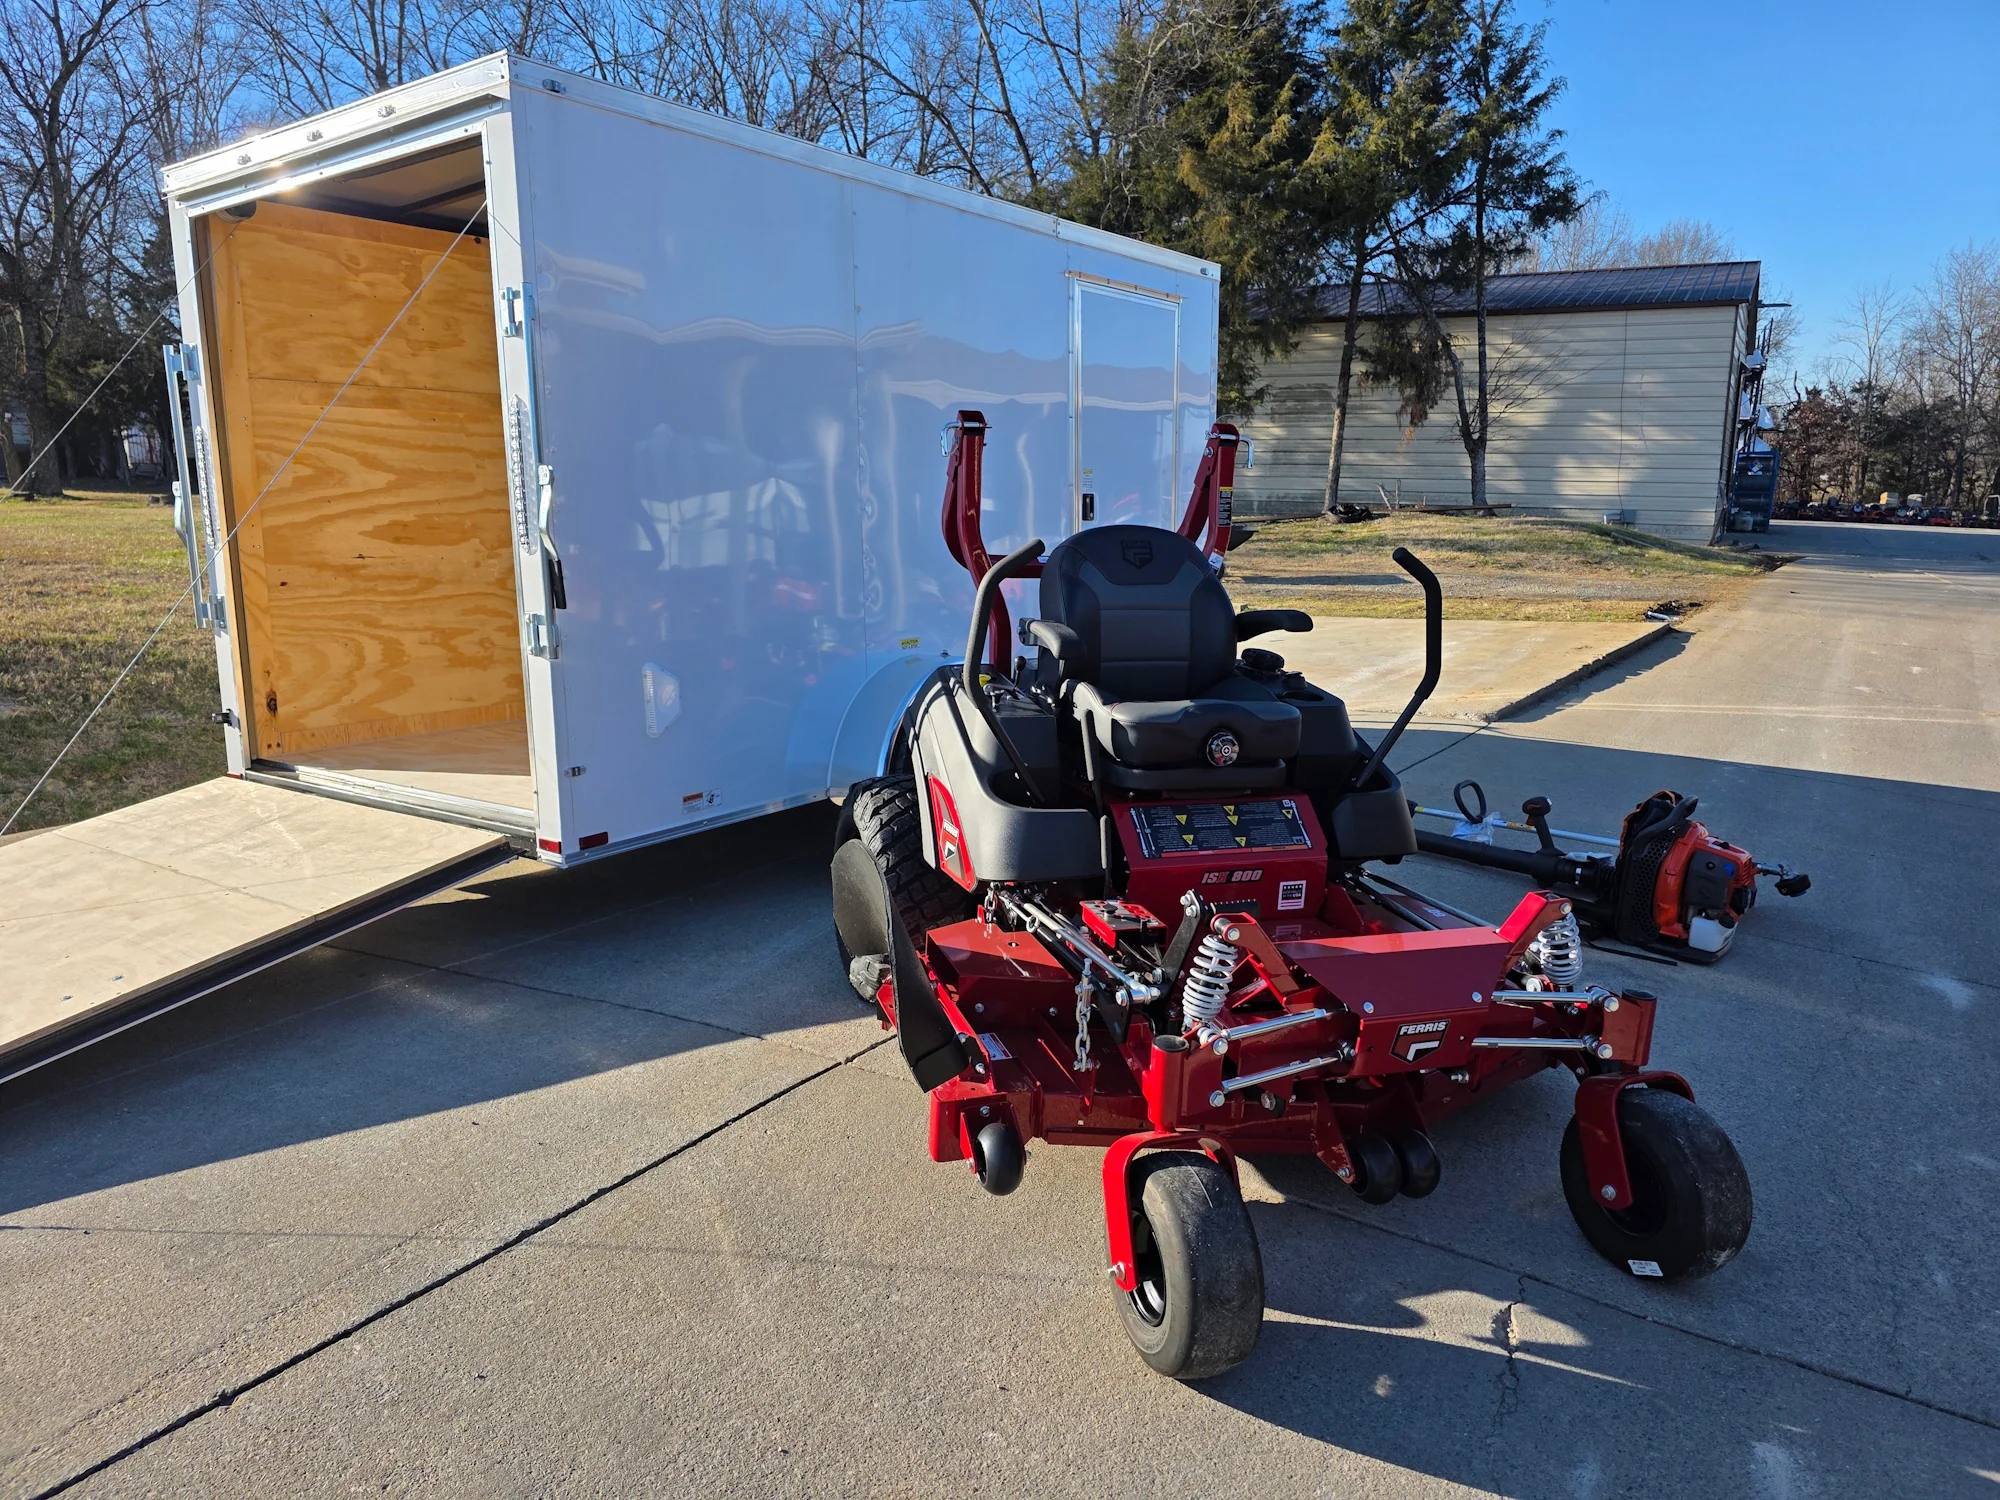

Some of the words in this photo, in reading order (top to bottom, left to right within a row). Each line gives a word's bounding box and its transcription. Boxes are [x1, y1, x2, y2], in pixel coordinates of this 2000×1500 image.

[1201, 871, 1229, 884] ISX
[1231, 869, 1263, 882] 800
[1399, 1021, 1447, 1036] FERRIS
